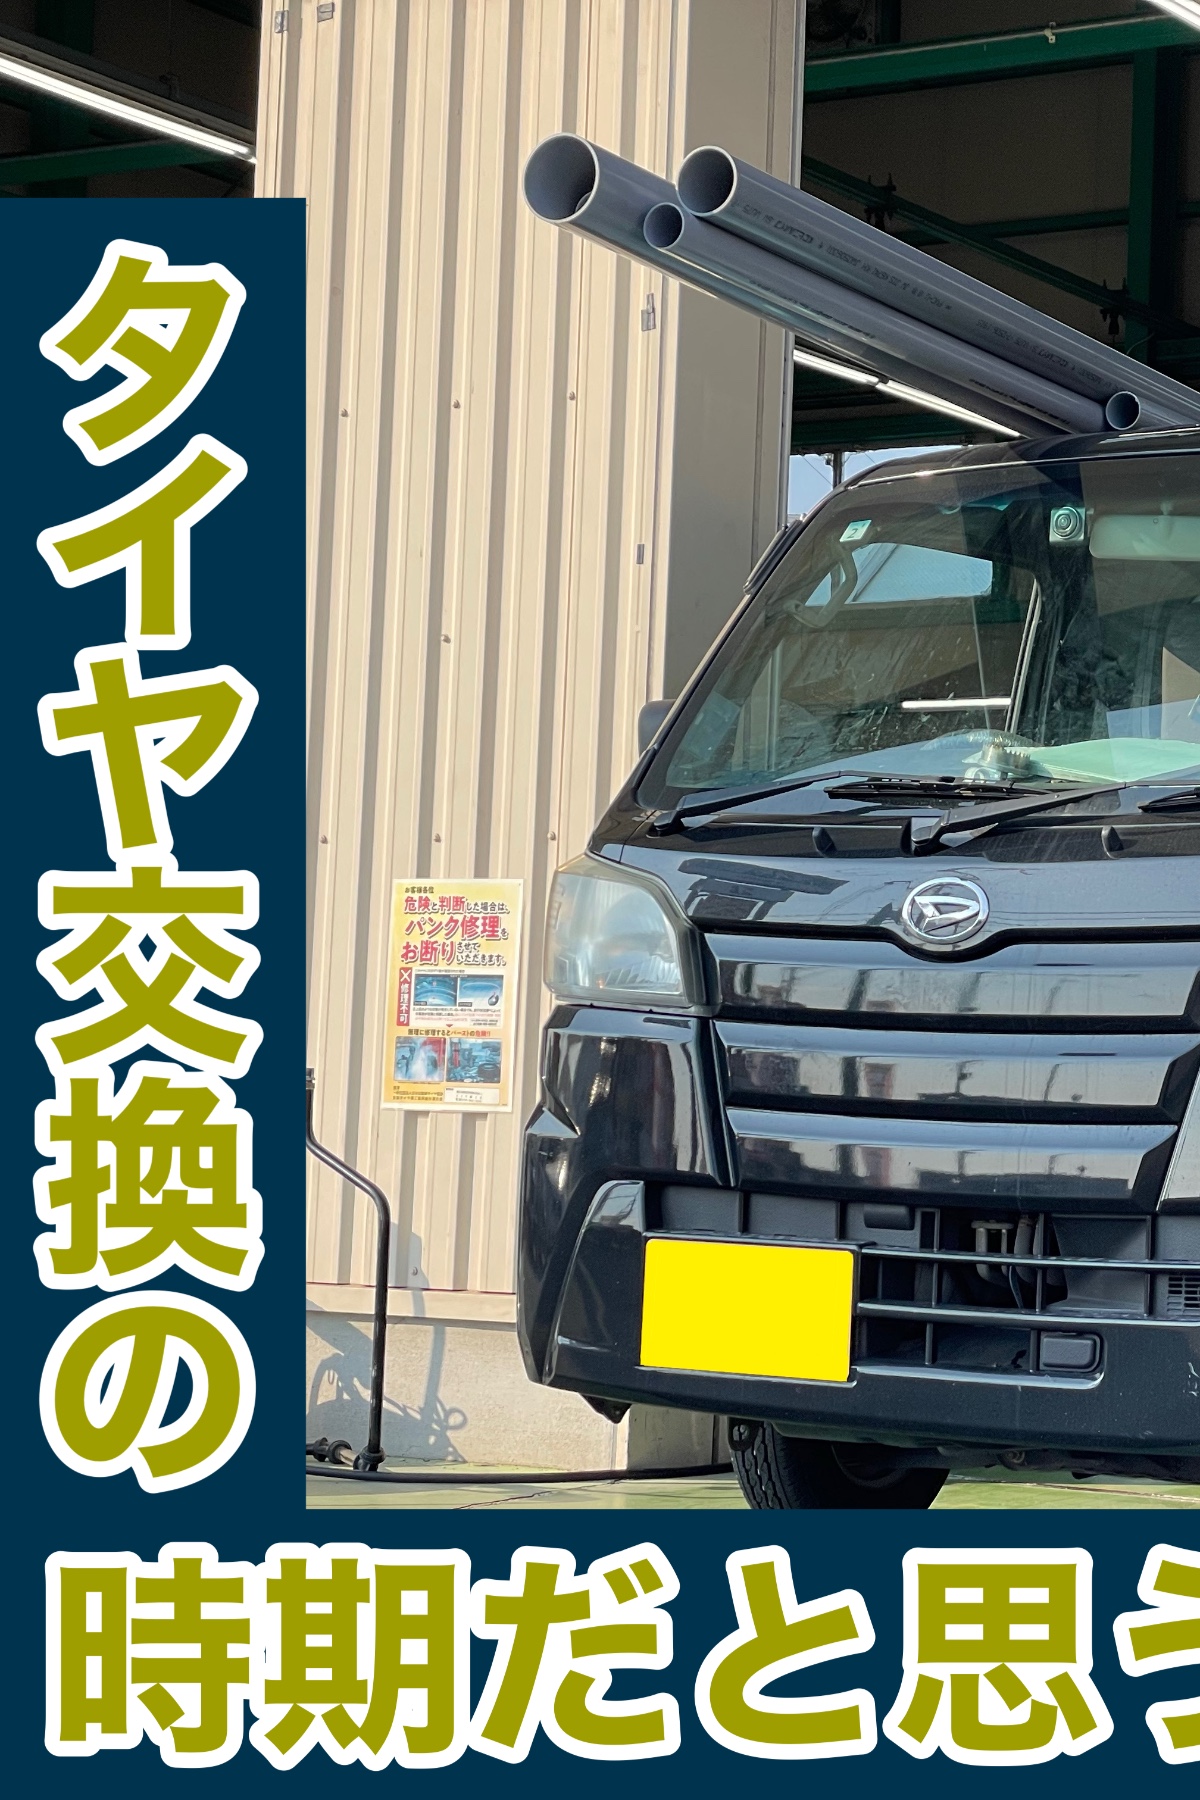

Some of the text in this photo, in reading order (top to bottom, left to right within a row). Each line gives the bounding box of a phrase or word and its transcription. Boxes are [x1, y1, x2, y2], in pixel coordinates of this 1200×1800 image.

[404, 895, 510, 915] 危険と判断した場合は、
[404, 915, 509, 941] パンク修理を
[401, 940, 456, 965] お断り
